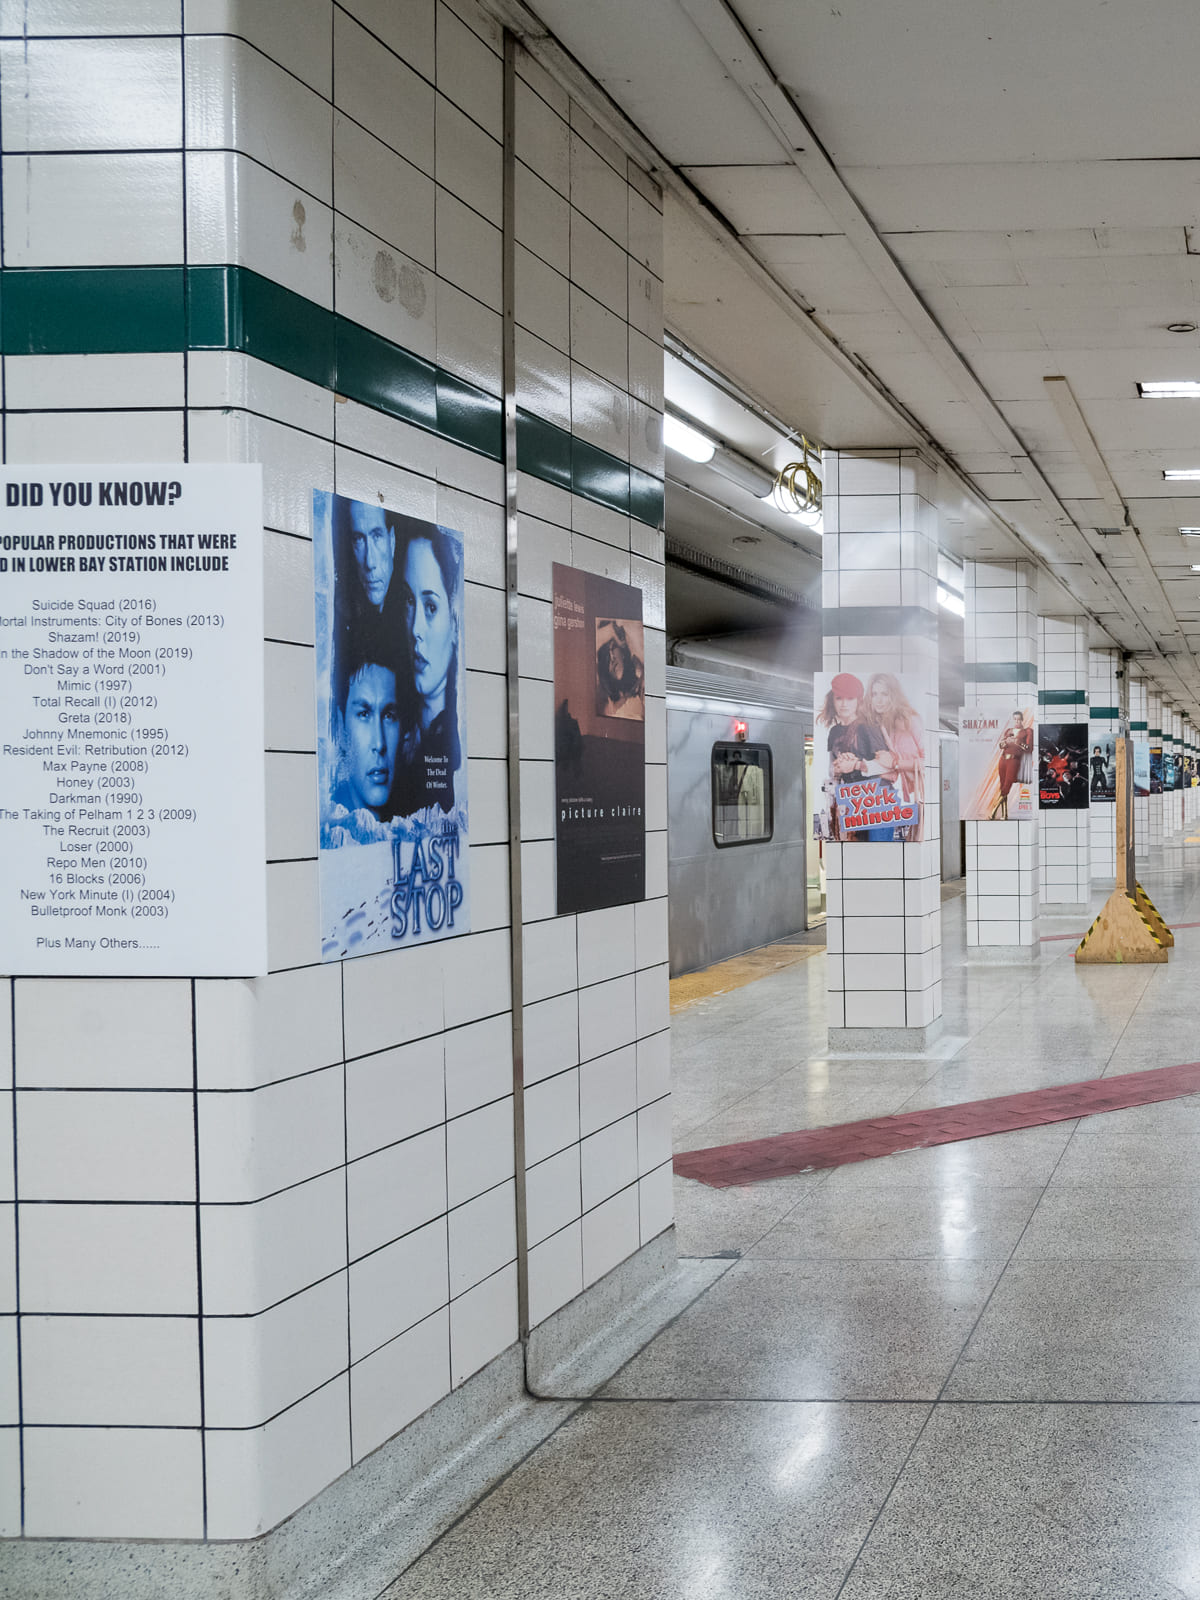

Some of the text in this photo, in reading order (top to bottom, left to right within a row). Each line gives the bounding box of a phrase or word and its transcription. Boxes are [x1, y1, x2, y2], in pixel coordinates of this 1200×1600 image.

[5, 481, 183, 507] DID YOU KNOW?
[58, 534, 157, 550] PRODUCTIONS
[158, 534, 195, 549] THAT
[197, 534, 238, 549] WERE
[11, 557, 26, 572] IN
[28, 557, 76, 572] LOWER
[78, 556, 106, 572] BAY
[108, 556, 168, 572] STATION
[170, 556, 230, 572] INCLUDE
[32, 599, 157, 612] Suicide Squad (2016)
[0, 615, 225, 628] ortal Instruments: City of Bones (2013)
[48, 632, 141, 644] Shazam! (2019)
[11, 649, 30, 658] the
[32, 648, 80, 658] Shadow
[82, 648, 95, 658] of
[96, 648, 116, 658] the
[118, 648, 151, 658] Moon
[154, 648, 193, 660] (2019)
[24, 664, 54, 675] Don't
[56, 664, 80, 677] Say
[93, 664, 125, 674] Word
[128, 664, 166, 676] (2001)
[57, 680, 132, 693] Mimic (1997)
[31, 696, 61, 707] Total
[64, 696, 100, 707] Recall
[119, 696, 158, 709] (2012)
[58, 712, 132, 725] Greta (2018)
[962, 719, 999, 729] SHAZAM!
[22, 728, 169, 742] Johnny Mnemonic (1995)
[3, 744, 189, 757] Resident Evil: Retribution (2012)
[424, 755, 443, 763] Welcome
[43, 761, 149, 774] Max Payne (2008)
[56, 777, 135, 790] Honey (2003)
[840, 782, 877, 798] new
[49, 793, 143, 806] Darkman (1990)
[850, 788, 896, 814] york
[22, 809, 61, 822] Taking
[64, 809, 76, 819] of
[78, 809, 123, 820] Pelham
[127, 809, 132, 819] 1
[136, 809, 145, 819] 2
[147, 809, 155, 820] 3
[158, 809, 197, 822] (2009)
[561, 804, 641, 822] picture claire
[844, 805, 914, 828] minute
[42, 825, 151, 838] The Recruit (2003)
[60, 841, 134, 854] Loser (2000)
[47, 857, 148, 870] Repo Men (2010)
[391, 834, 459, 888] LAST
[49, 873, 146, 887] 16 Blocks (2006)
[20, 889, 46, 900] New
[49, 889, 76, 900] York
[79, 889, 118, 900] Minute
[137, 890, 176, 903] (2004)
[31, 903, 169, 918] Bulletproof Monk (2003)
[390, 879, 463, 940] STOP
[36, 937, 62, 948] Plus
[64, 937, 97, 951] Many
